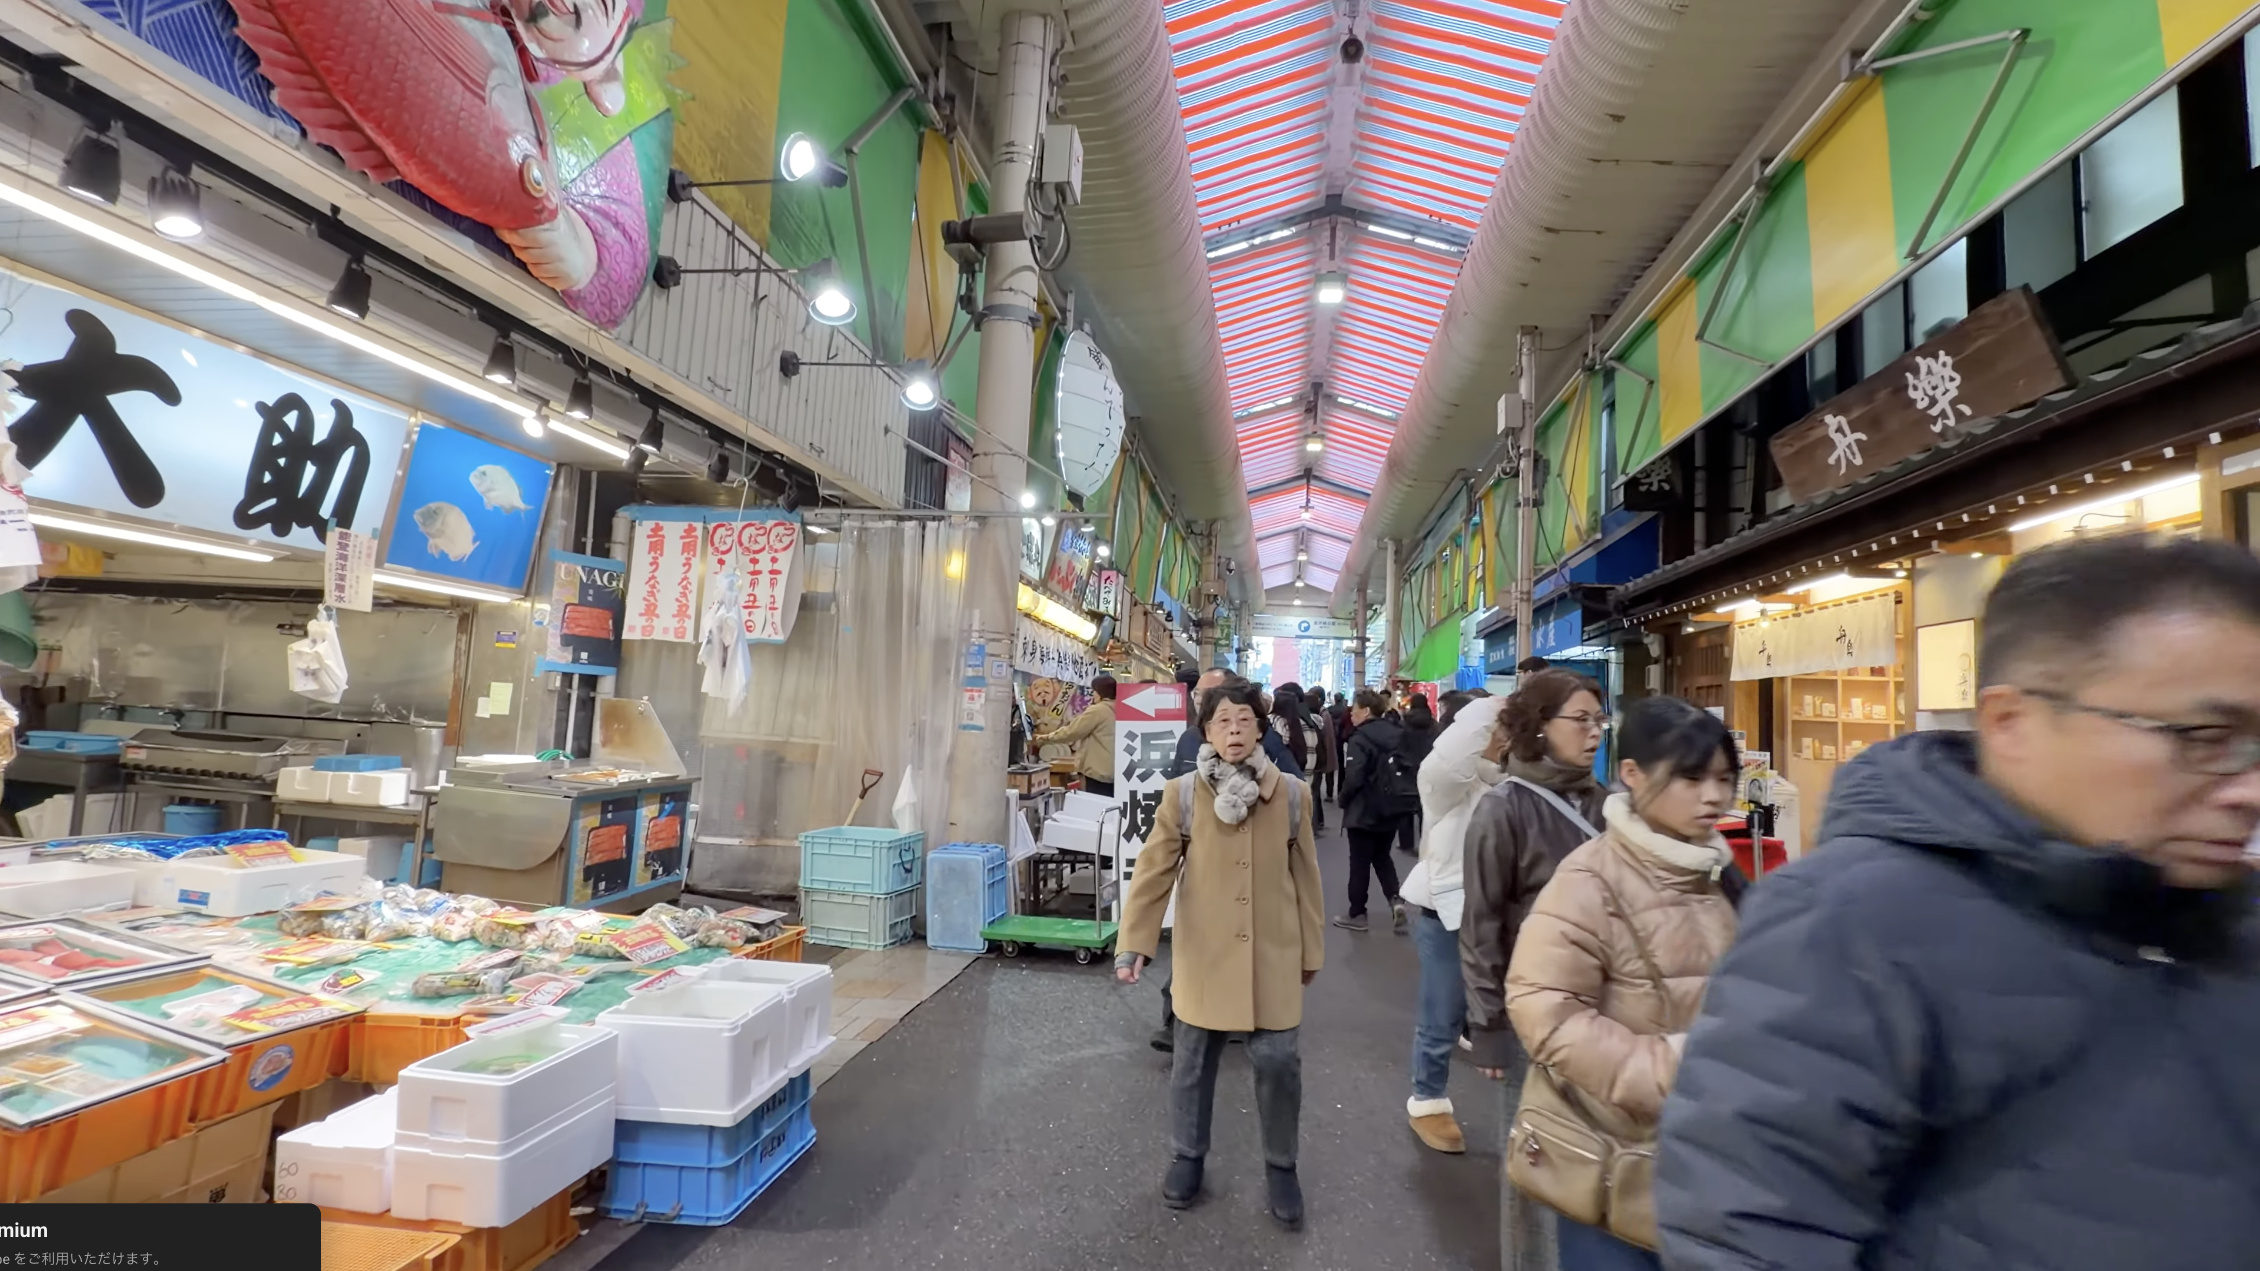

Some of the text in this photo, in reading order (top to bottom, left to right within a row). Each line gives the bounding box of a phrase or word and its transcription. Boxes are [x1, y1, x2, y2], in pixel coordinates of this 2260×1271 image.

[4, 308, 371, 545] 大助
[333, 531, 352, 604] 能登海洋深層水
[559, 563, 625, 589] UNAGI
[638, 522, 666, 638] 土用うなぎ丑の日
[671, 523, 699, 640] 土用うなぎ丑の日
[1121, 730, 1178, 881] 浜焼
